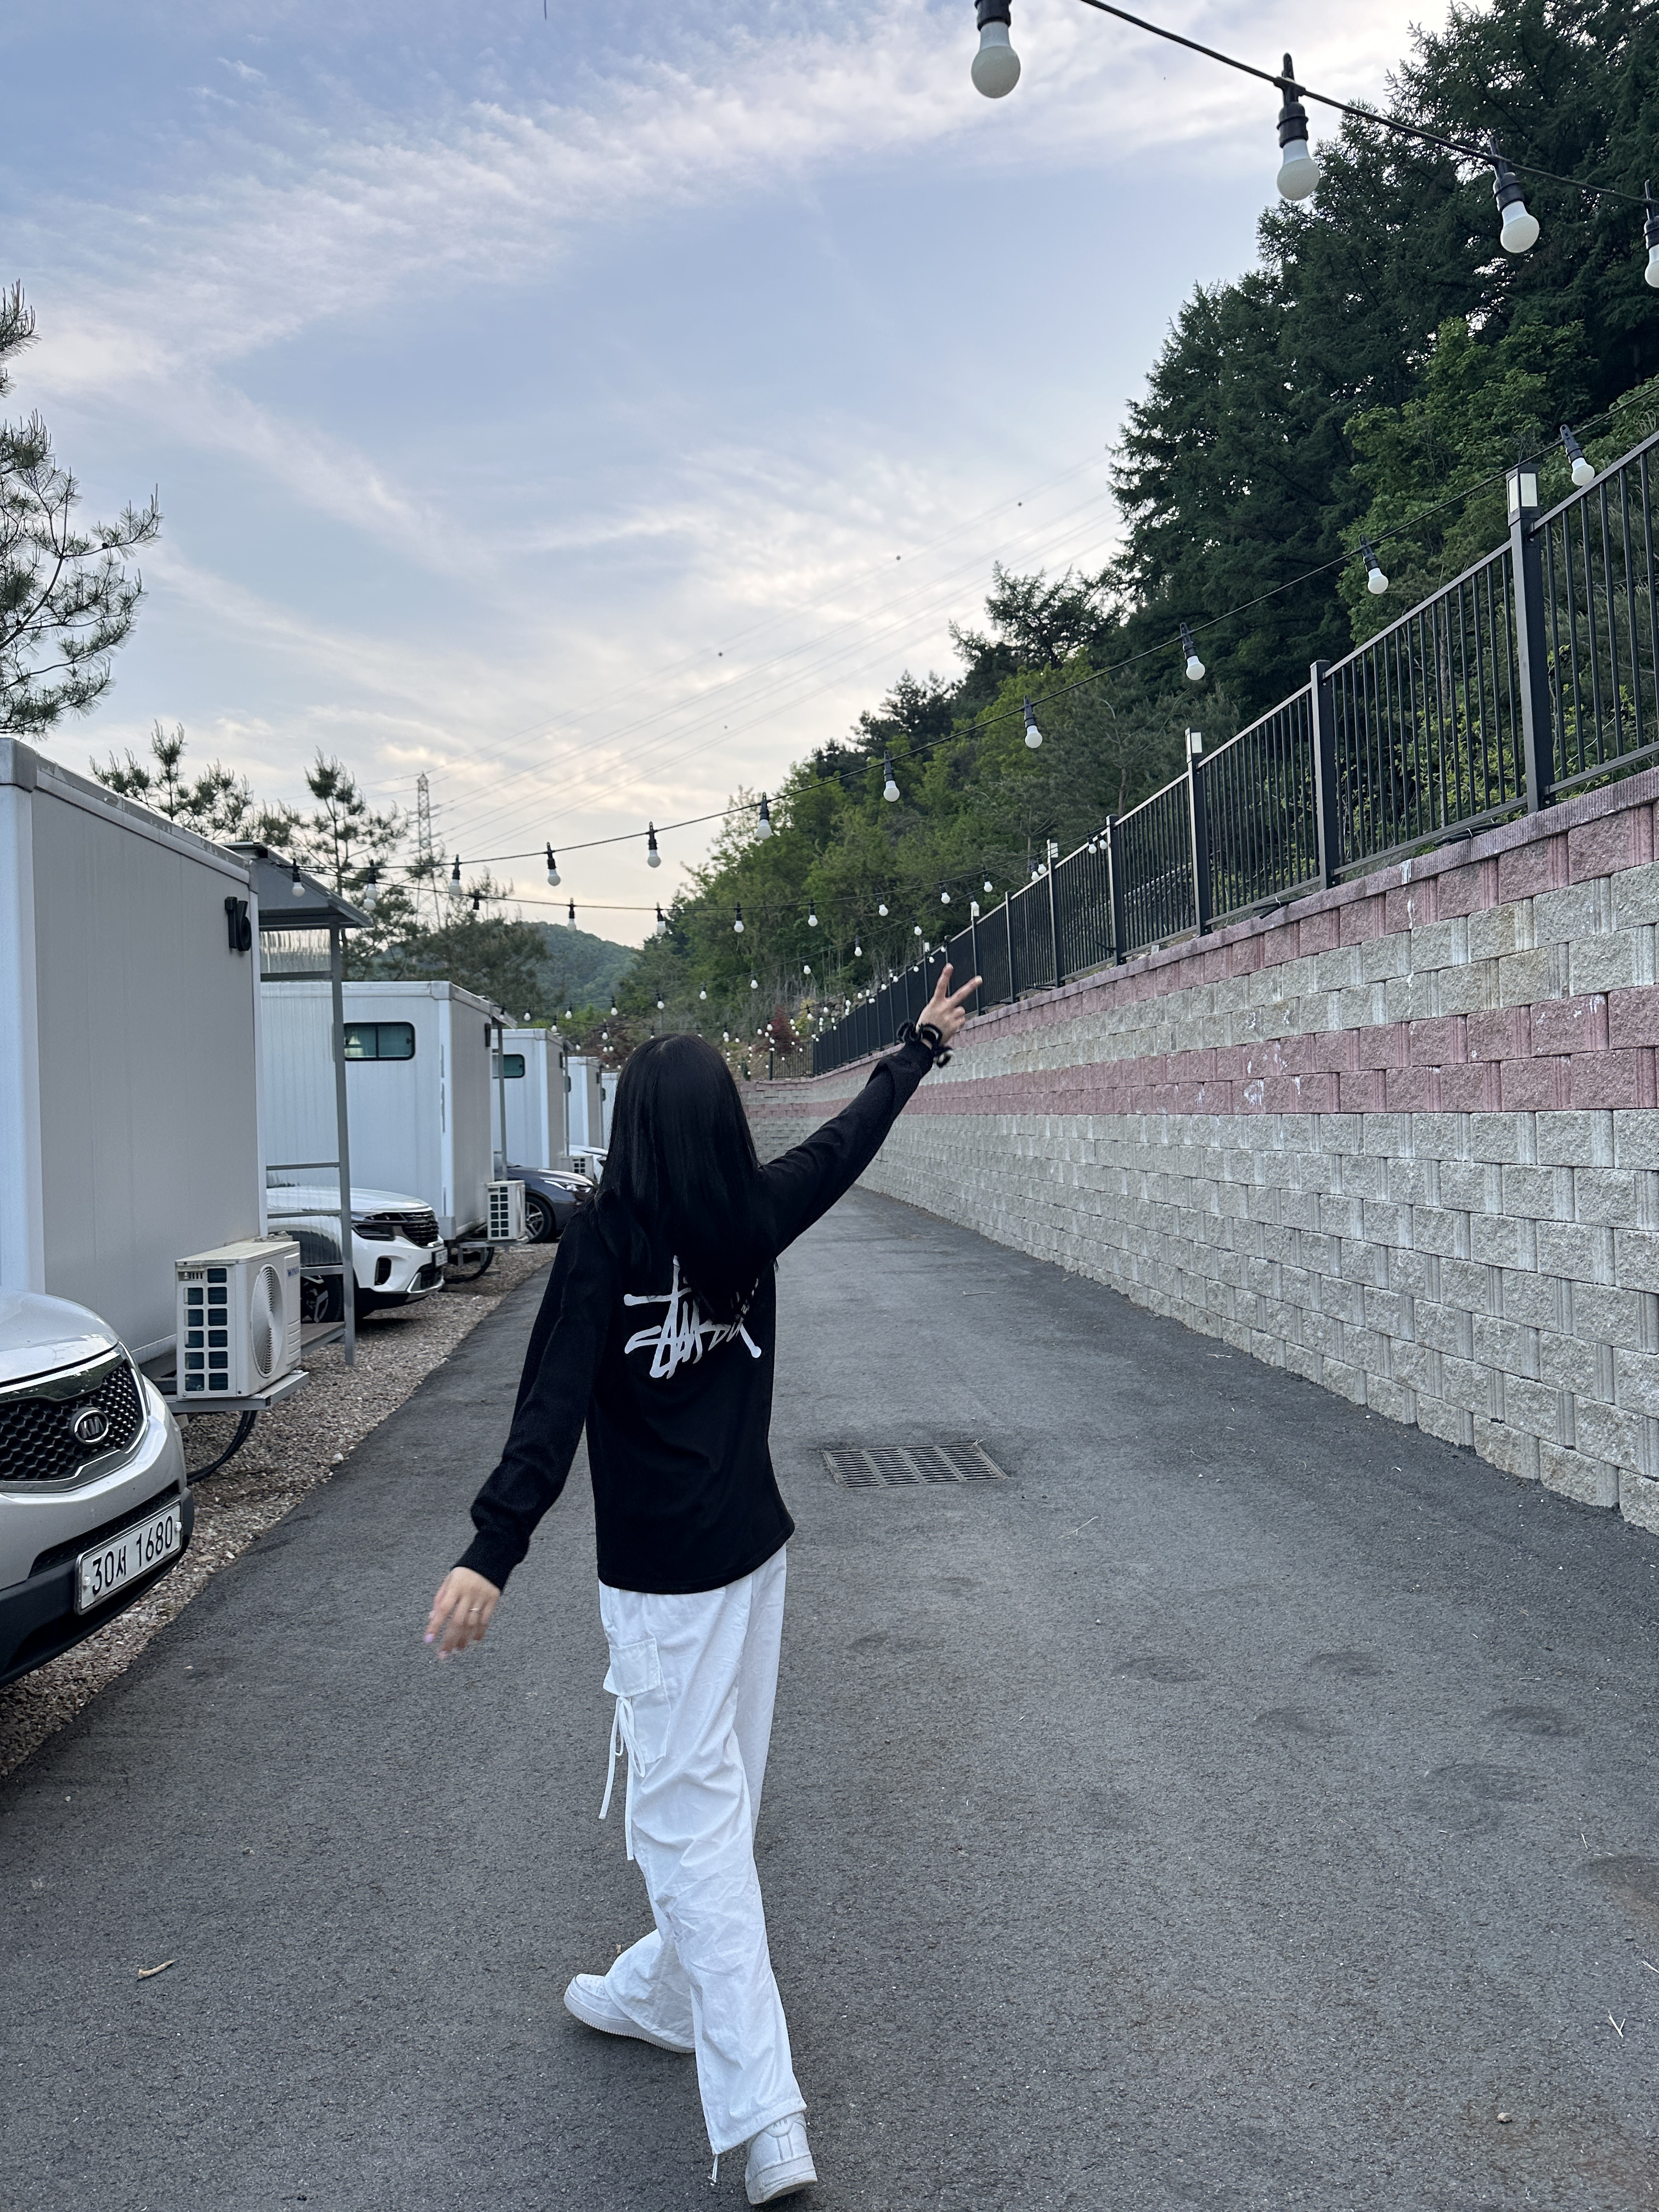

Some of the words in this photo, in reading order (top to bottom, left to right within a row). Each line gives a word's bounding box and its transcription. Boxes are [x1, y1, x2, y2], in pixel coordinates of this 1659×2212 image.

[224, 896, 252, 951] 16
[80, 1416, 104, 1439] KIA
[92, 1545, 127, 1596] 30서
[136, 1515, 173, 1568] 1680
